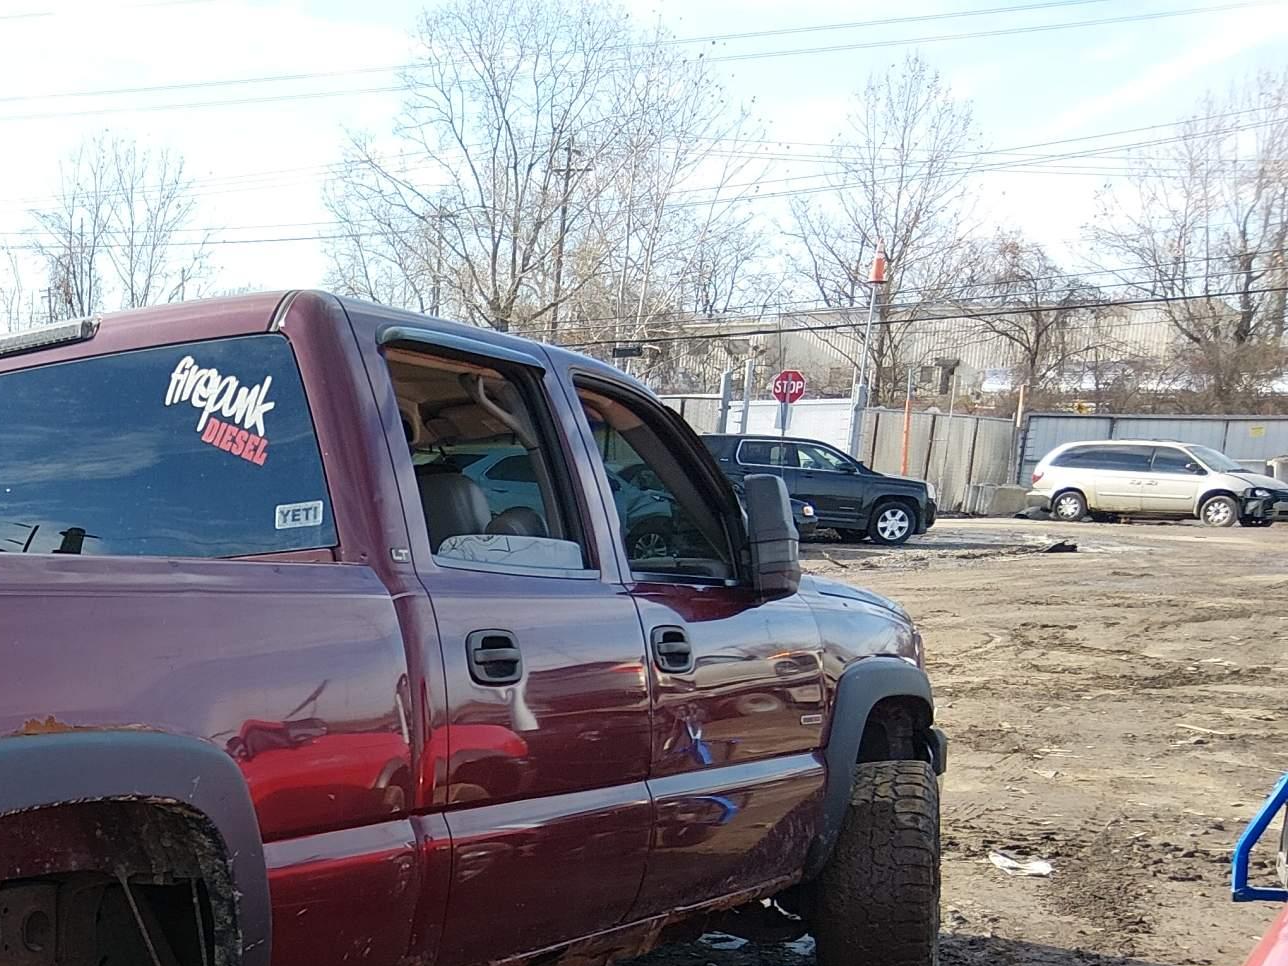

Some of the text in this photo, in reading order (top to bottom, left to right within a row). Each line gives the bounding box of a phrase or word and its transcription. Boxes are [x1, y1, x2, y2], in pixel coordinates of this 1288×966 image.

[165, 355, 275, 437] firepunk
[774, 380, 804, 394] STOP
[201, 417, 269, 467] DIESEL
[279, 506, 318, 524] YETI
[392, 549, 409, 561] LT
